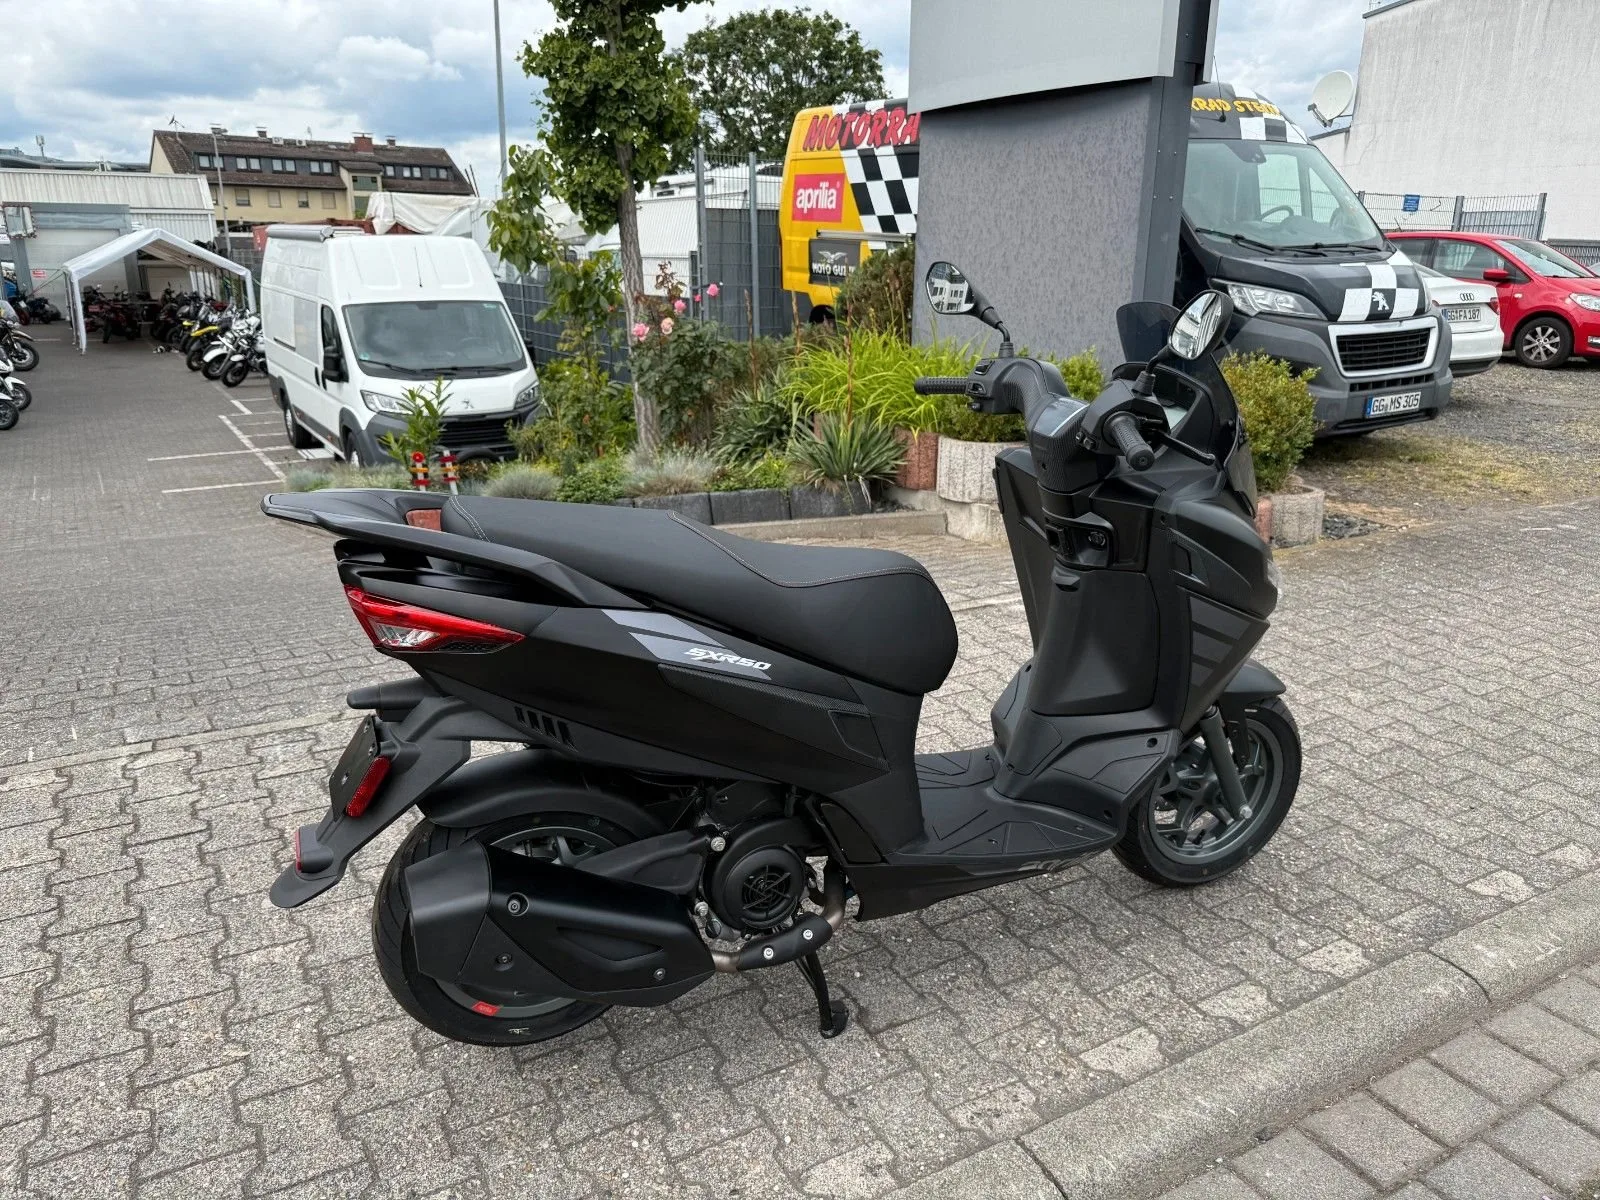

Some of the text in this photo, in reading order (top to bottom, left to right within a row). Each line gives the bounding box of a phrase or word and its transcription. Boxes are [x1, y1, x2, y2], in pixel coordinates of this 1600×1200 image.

[796, 181, 837, 214] aprilia
[812, 262, 832, 275] MOTO
[1402, 393, 1420, 409] 305
[684, 647, 772, 671] SXR50
